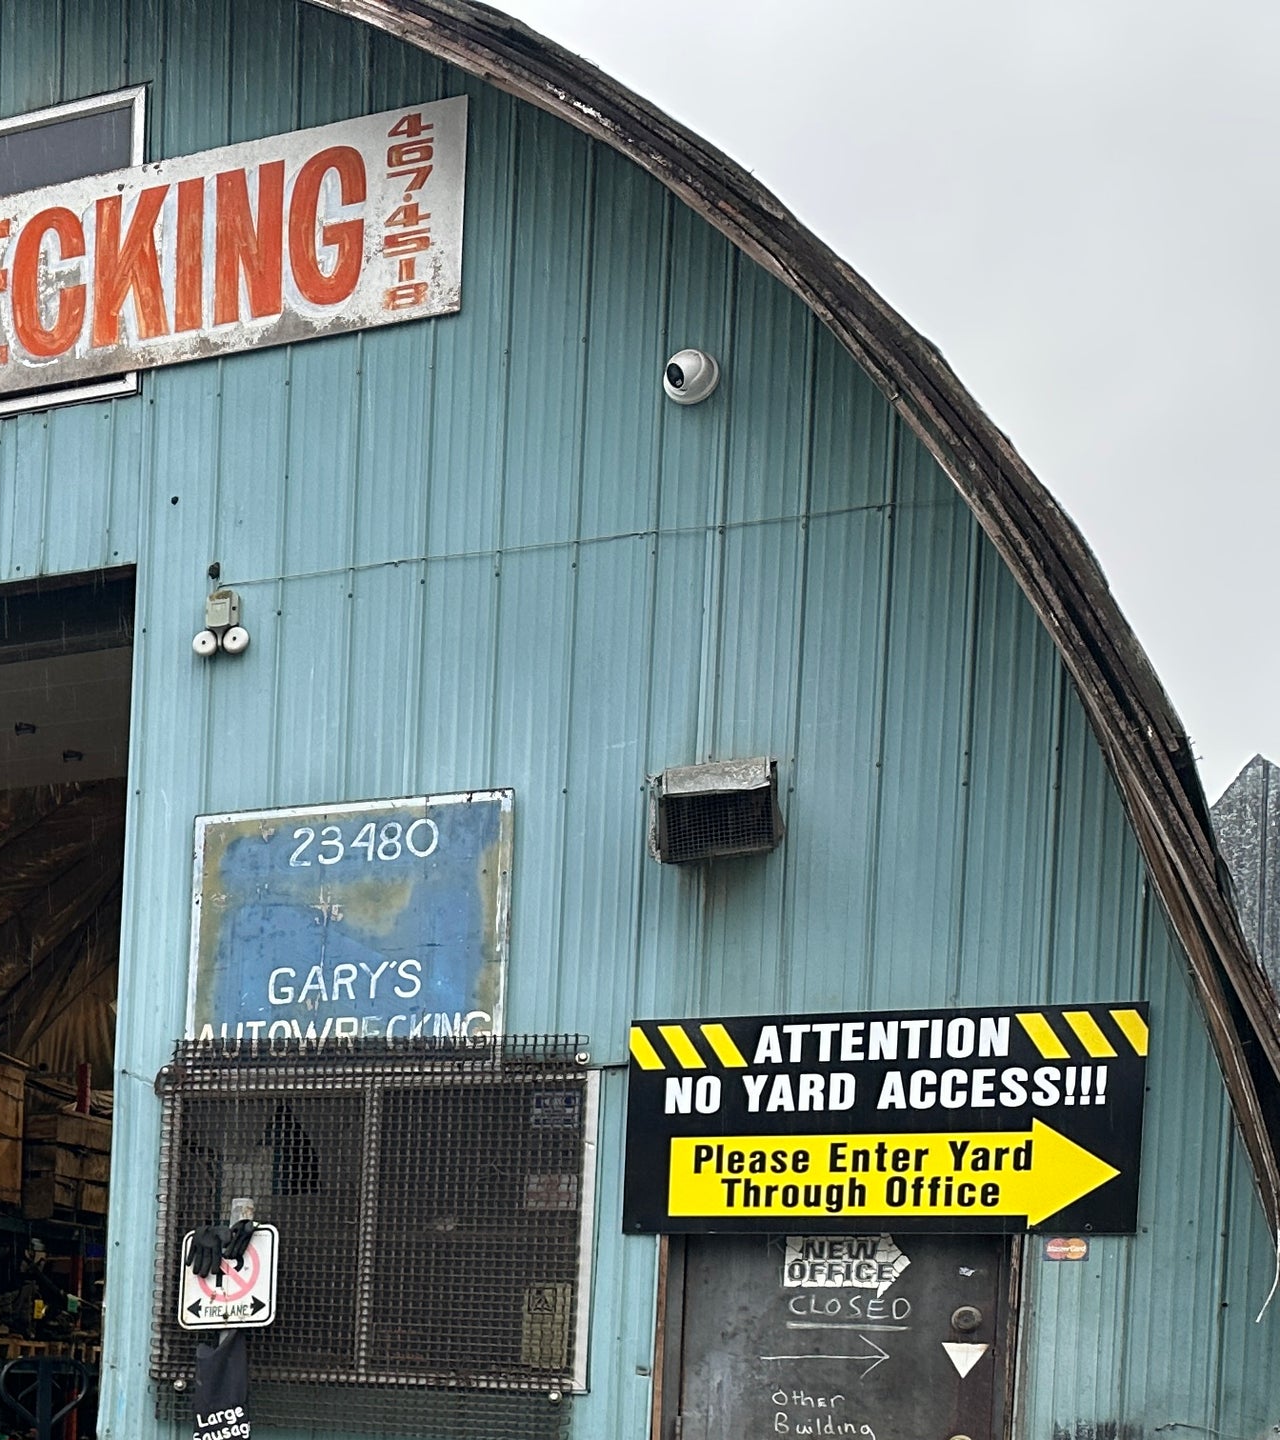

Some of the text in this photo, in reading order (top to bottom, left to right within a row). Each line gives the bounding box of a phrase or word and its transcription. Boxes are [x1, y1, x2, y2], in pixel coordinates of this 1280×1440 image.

[288, 818, 439, 867] 23480
[268, 958, 422, 1006] GARY'S
[753, 1016, 1011, 1064] ATTENTION
[665, 1064, 1108, 1114] NO YARD ACCESS!!!
[692, 1138, 1034, 1174] Please Enter Yard
[721, 1175, 1001, 1213] Through Office
[802, 1239, 878, 1260] NEW
[786, 1260, 895, 1282] OFFICE
[204, 1305, 223, 1317] FIRE
[788, 1294, 912, 1320] CLOSED
[196, 1406, 245, 1428] Large
